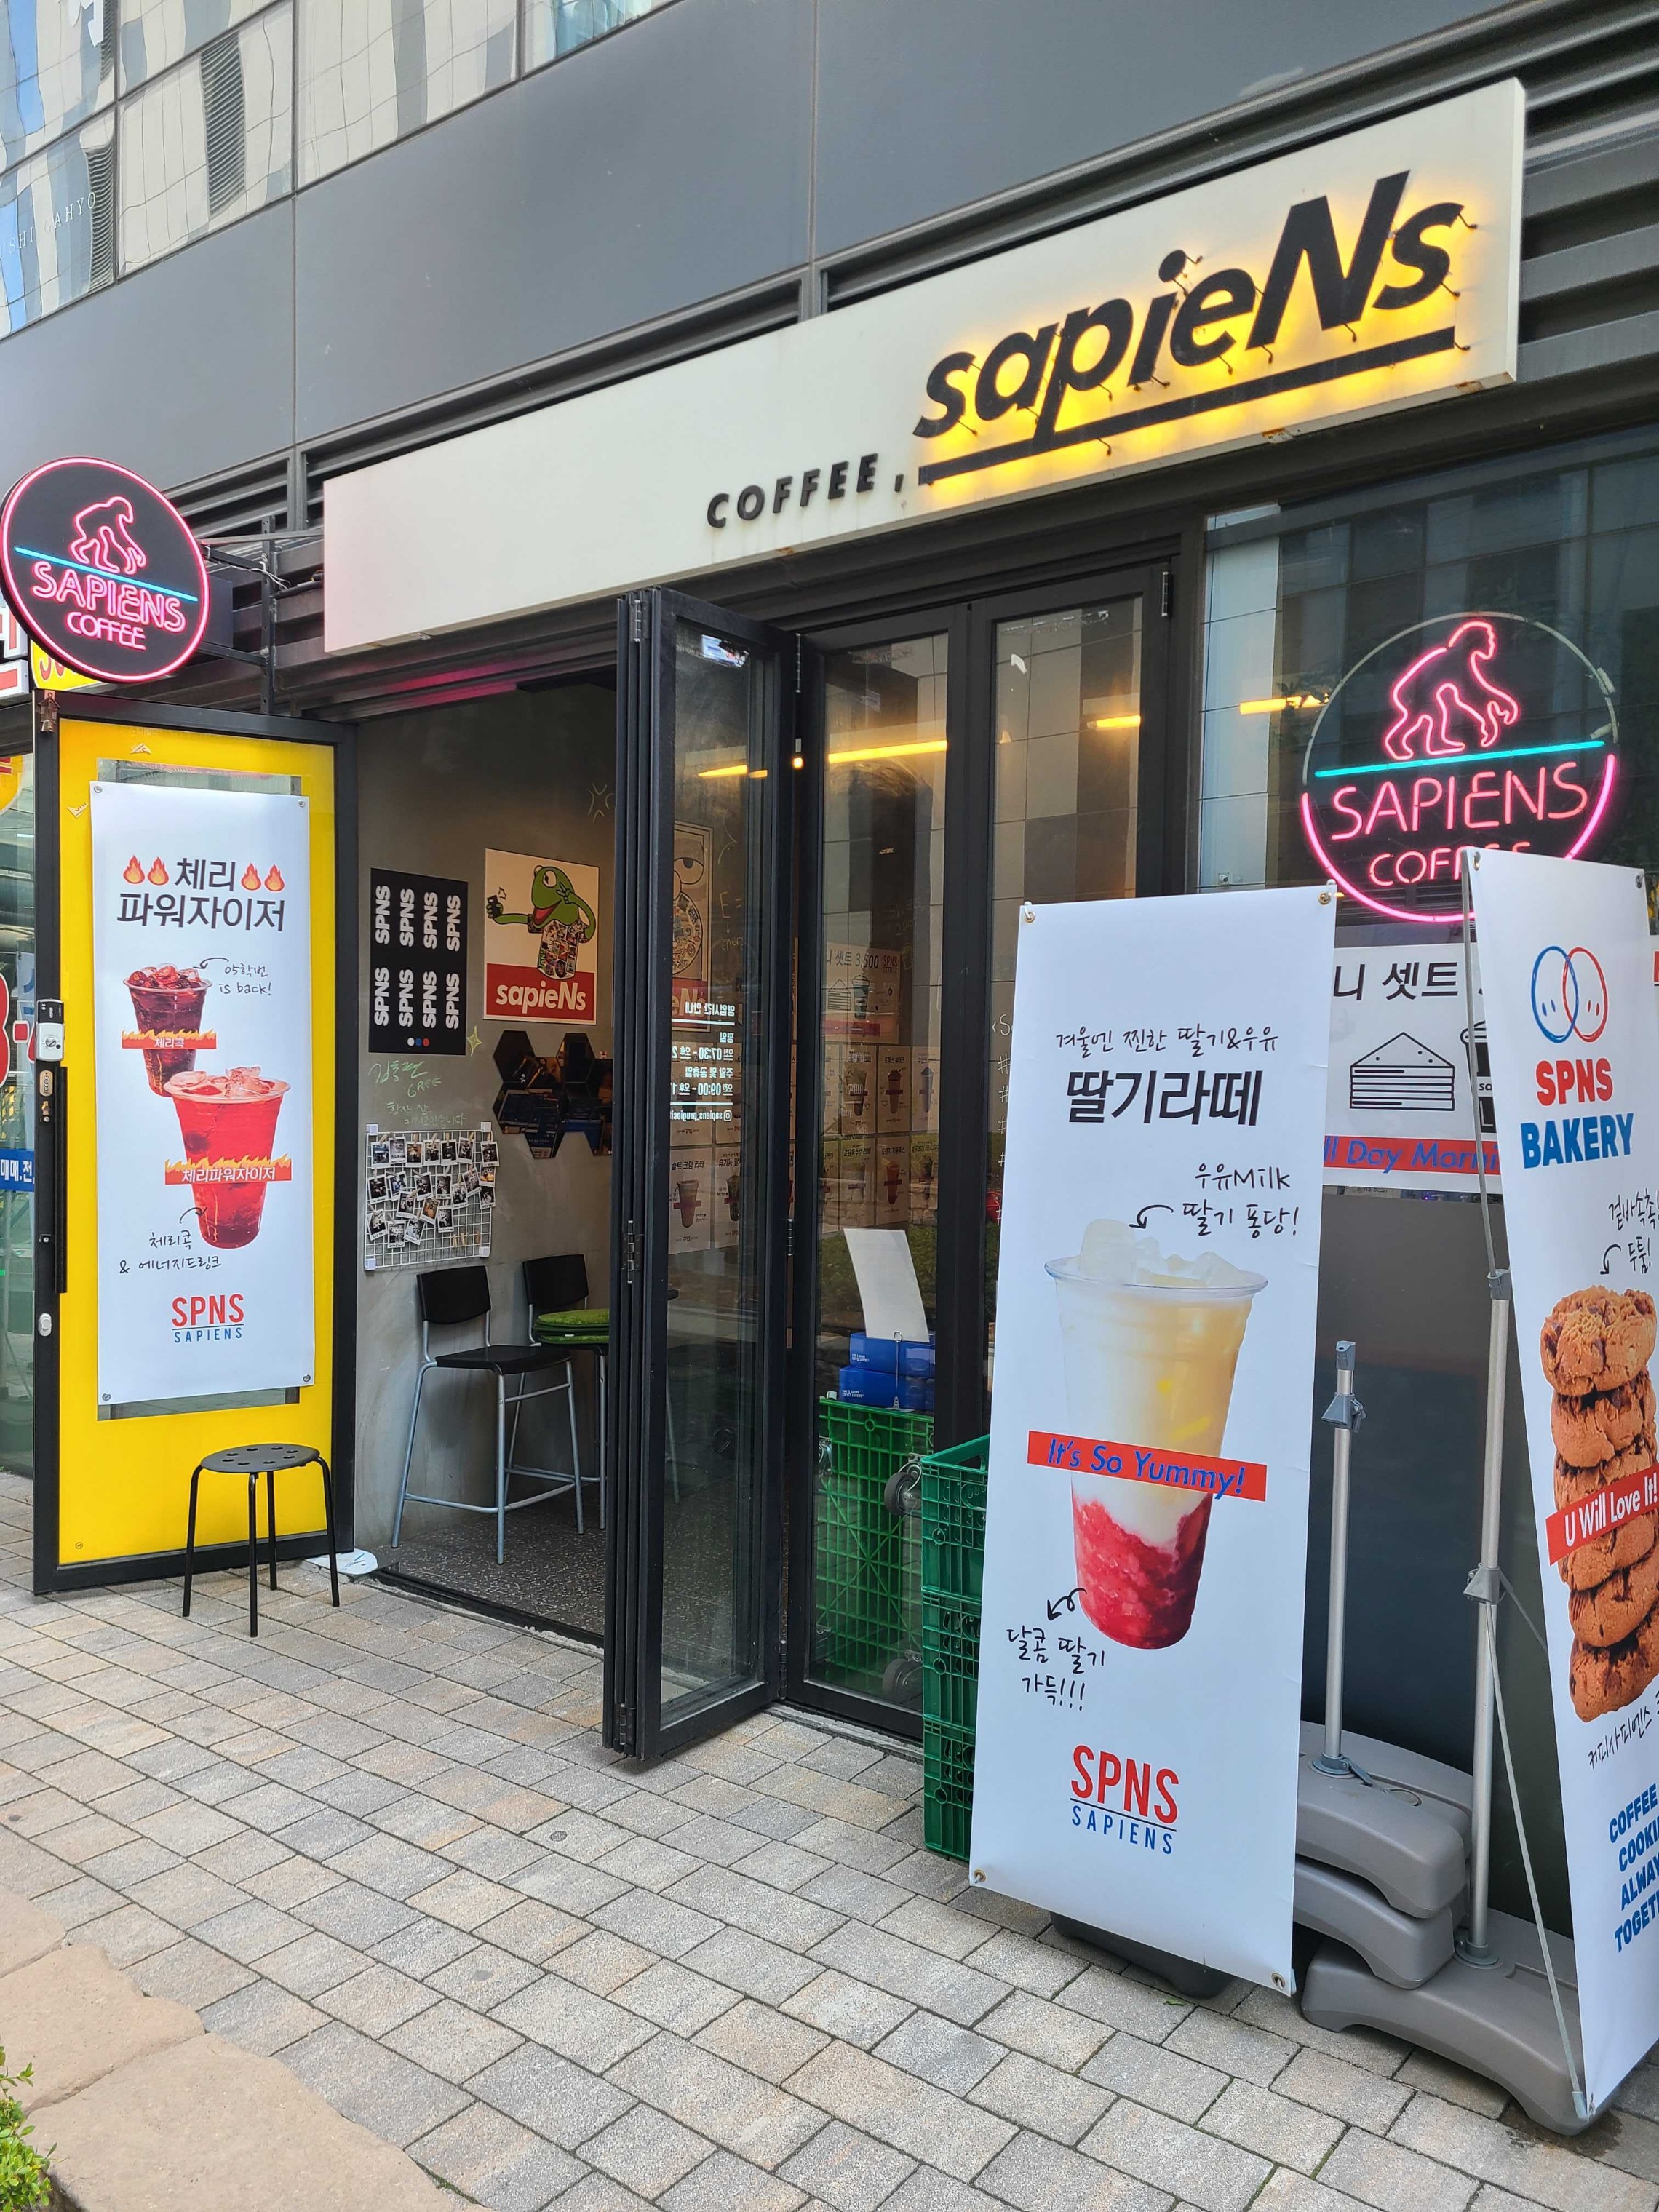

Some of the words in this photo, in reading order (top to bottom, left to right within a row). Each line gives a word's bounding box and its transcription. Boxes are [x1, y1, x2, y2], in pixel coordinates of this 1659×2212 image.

[912, 169, 1465, 438] sapieNs
[31, 560, 186, 634] SAPIENS
[66, 610, 146, 651] COFFEE
[1332, 761, 1588, 840] SAPIENS
[175, 857, 236, 891] 체리
[117, 893, 285, 931] 파워자이저
[375, 885, 391, 944] SPNS
[400, 888, 415, 947] SPNS
[423, 891, 437, 950] SPNS
[447, 895, 461, 952] SPNS
[218, 982, 231, 994] is
[237, 982, 271, 995] back!
[374, 967, 390, 1027] SPNS
[399, 969, 414, 1027] SPNS
[422, 971, 437, 1029] SPNS
[445, 973, 460, 1030] SPNS
[496, 980, 586, 1014] sapieNs
[1333, 963, 1366, 1000] 니
[1382, 961, 1458, 1000] 셋트
[1056, 1026, 1113, 1059] 겨울엔
[1178, 1023, 1279, 1057] 딸기&우유
[1067, 1070, 1262, 1126] 딸기라떼
[1535, 1057, 1613, 1107] SPNS
[1347, 1139, 1403, 1174] Day
[1520, 1113, 1634, 1169] BAKERY
[182, 1167, 275, 1182] 체리파워자이저
[149, 1230, 192, 1249] 체리콕
[1182, 1199, 1233, 1236] 딸기
[1246, 1204, 1299, 1238] 퐁당!
[119, 1260, 130, 1273] &
[138, 1256, 221, 1270] 에너지드링크
[172, 1294, 244, 1327] SPNS
[174, 1327, 242, 1343] SAPIENS
[1048, 1438, 1081, 1468] It's
[1089, 1445, 1122, 1473] So
[1134, 1450, 1246, 1500] Yummy!
[1565, 1511, 1575, 1547] U
[1578, 1492, 1607, 1539] Will
[1610, 1490, 1640, 1523] Love
[1644, 1472, 1658, 1506] It!
[1006, 1625, 1049, 1664] 달콤
[1058, 1637, 1105, 1674] 딸기
[1070, 1744, 1179, 1824] SPNS
[1072, 1805, 1173, 1855] SAPIENS
[1609, 1783, 1658, 1843] COFFEE
[1618, 1815, 1659, 1872] COOKI
[1620, 1852, 1659, 1911] ALWAY
